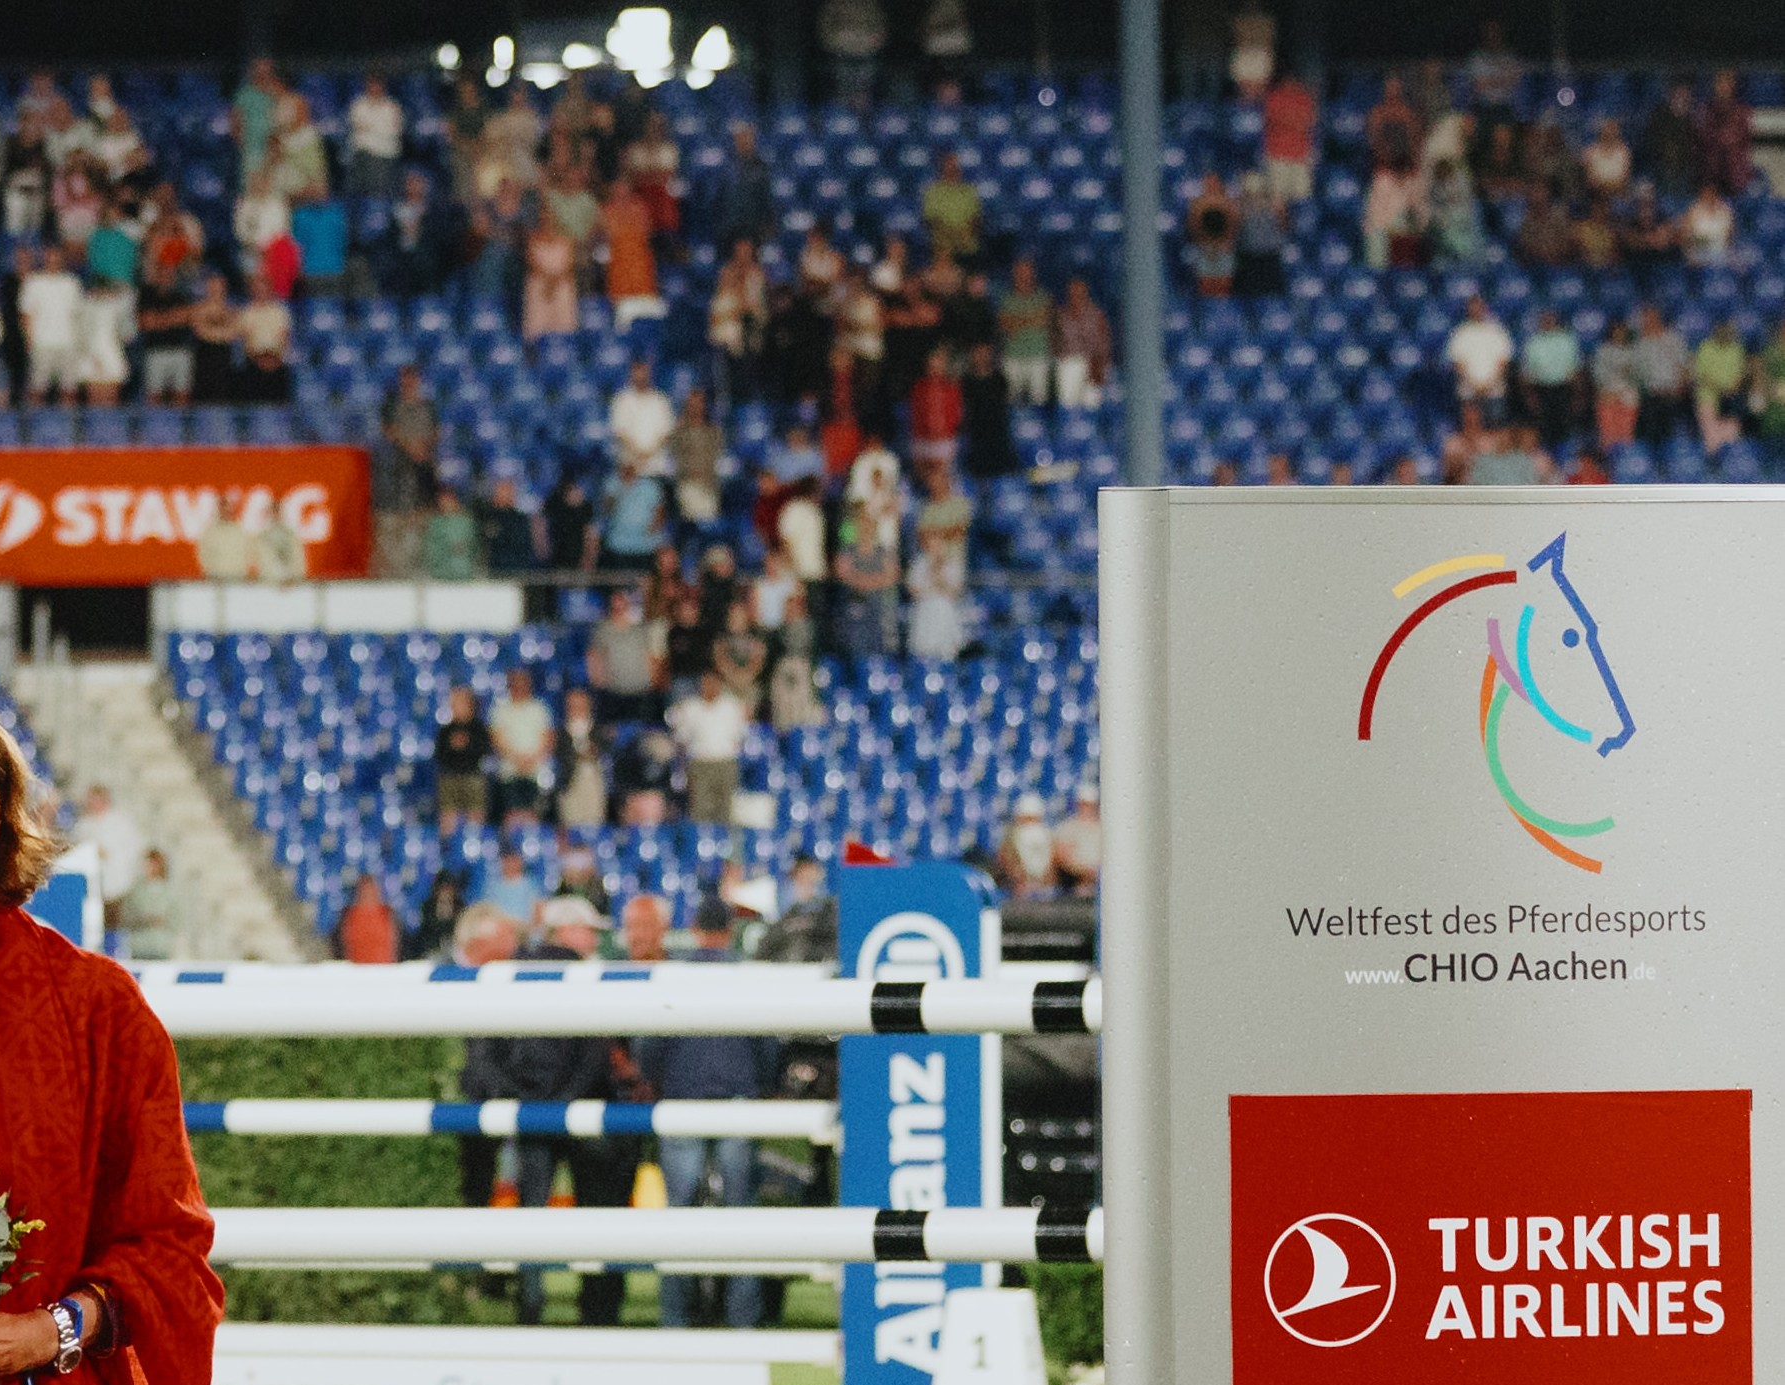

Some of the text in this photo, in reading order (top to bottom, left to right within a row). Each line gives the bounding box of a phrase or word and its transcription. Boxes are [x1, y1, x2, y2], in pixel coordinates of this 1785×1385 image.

[1286, 904, 1707, 937] Weltfest des Pferdesports
[874, 1052, 947, 1375] Allanz
[1428, 1213, 1720, 1272] TURKISH
[1425, 1280, 1725, 1340] AIRLINES
[972, 1335, 989, 1369] 1
